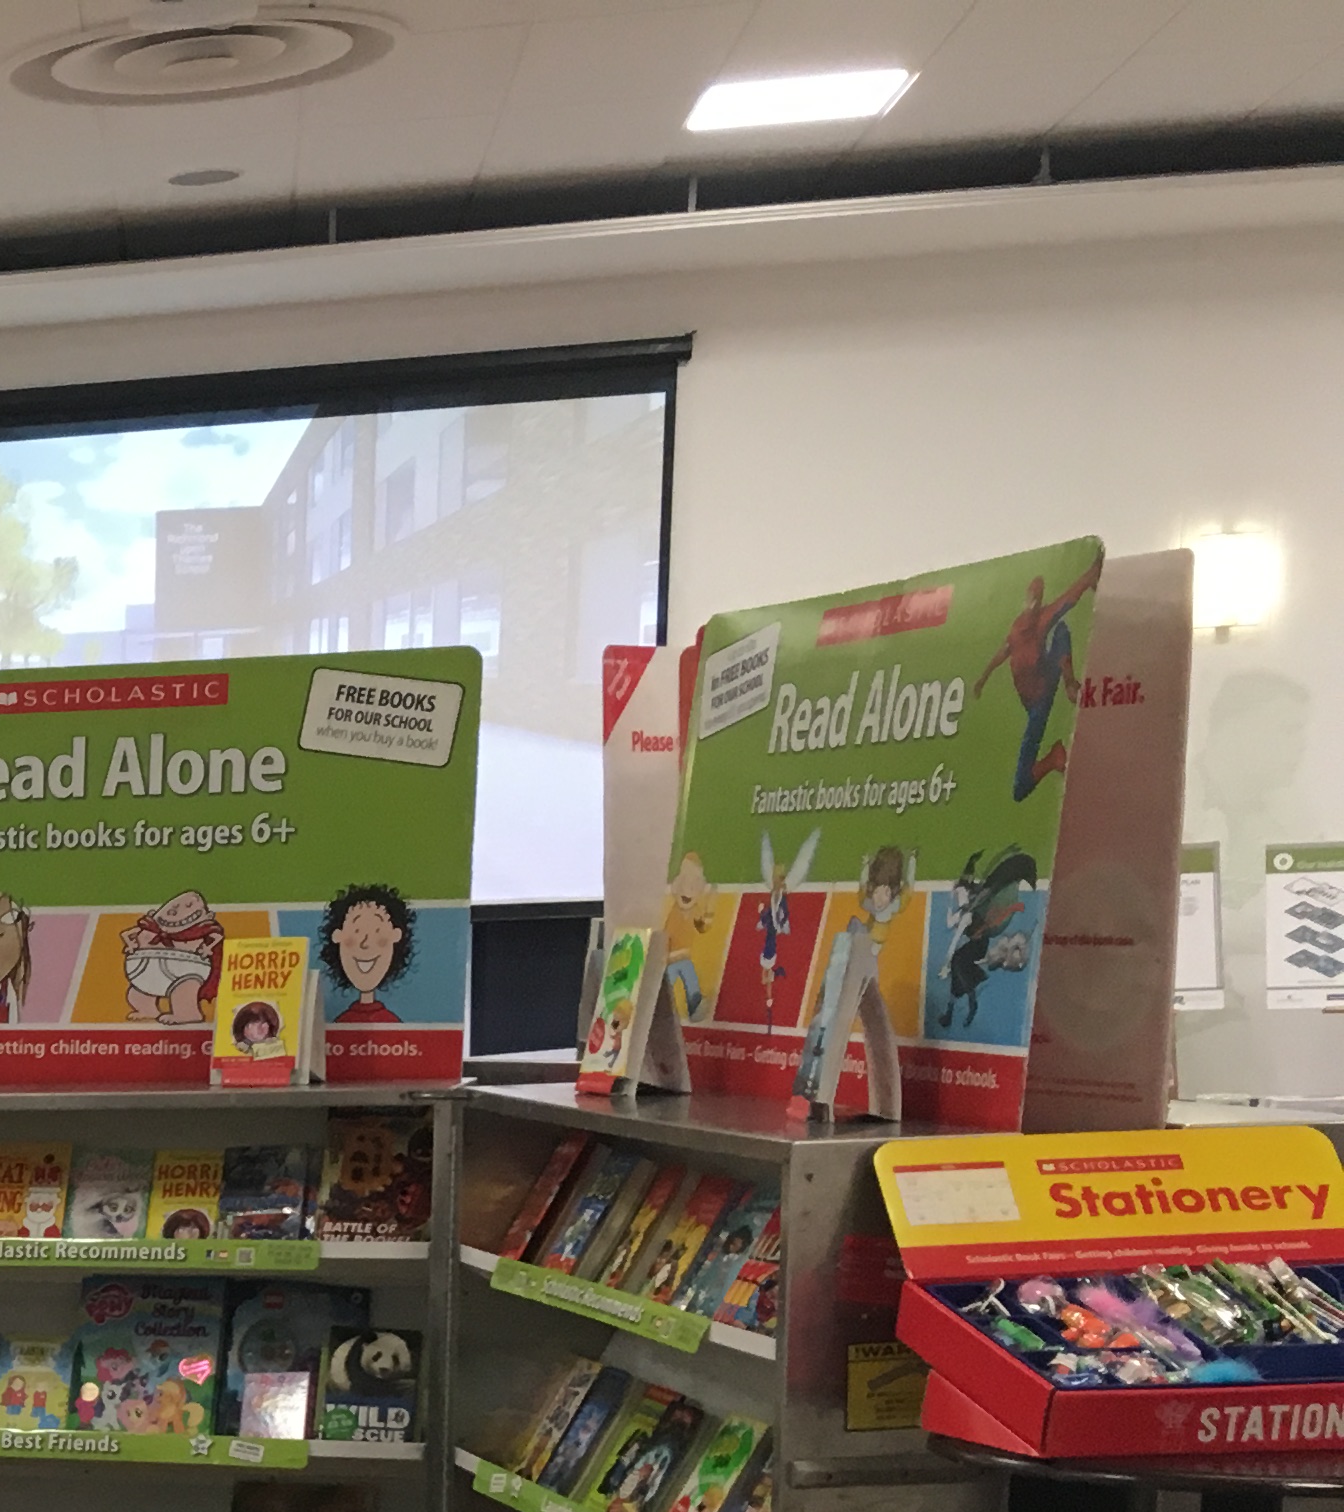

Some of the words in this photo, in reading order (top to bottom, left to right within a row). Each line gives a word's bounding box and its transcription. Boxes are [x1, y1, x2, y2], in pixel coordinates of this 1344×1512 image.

[24, 681, 221, 707] SCHOLASTIC
[335, 684, 376, 705] FREE
[378, 689, 437, 712] BOOKS
[1102, 675, 1145, 707] Fair.
[327, 707, 353, 722] FOR
[355, 710, 382, 726] OUR
[383, 714, 434, 732] SCHOOL
[768, 670, 859, 754] Read
[854, 664, 965, 745] Alone
[316, 726, 348, 739] when
[350, 730, 372, 743] you
[372, 731, 395, 747] buy
[631, 730, 674, 752] Please
[102, 732, 287, 799] Alone
[751, 780, 813, 815] Fantastic
[815, 777, 861, 811] books
[863, 774, 886, 808] for
[887, 777, 925, 814] ages
[928, 763, 957, 803] 6+
[45, 820, 128, 849] books
[133, 820, 173, 848] for
[179, 824, 243, 853] ages
[250, 811, 297, 844] 6+
[230, 968, 293, 992] HENRY
[50, 1039, 120, 1055] children
[124, 1039, 197, 1059] reading.
[326, 1042, 345, 1056] to
[349, 1039, 424, 1057] schools.
[941, 1068, 953, 1084] to
[955, 1068, 1000, 1088] schools.
[1058, 1156, 1180, 1173] SCHOLASTIC
[1048, 1177, 1331, 1221] Stationery
[322, 1221, 373, 1233] BATTLE
[375, 1222, 398, 1233] OF
[54, 1241, 186, 1262] Recommends
[151, 1304, 196, 1326] Story
[134, 1320, 211, 1337] Collection
[1, 1433, 43, 1450] Best
[48, 1434, 119, 1453] Friends
